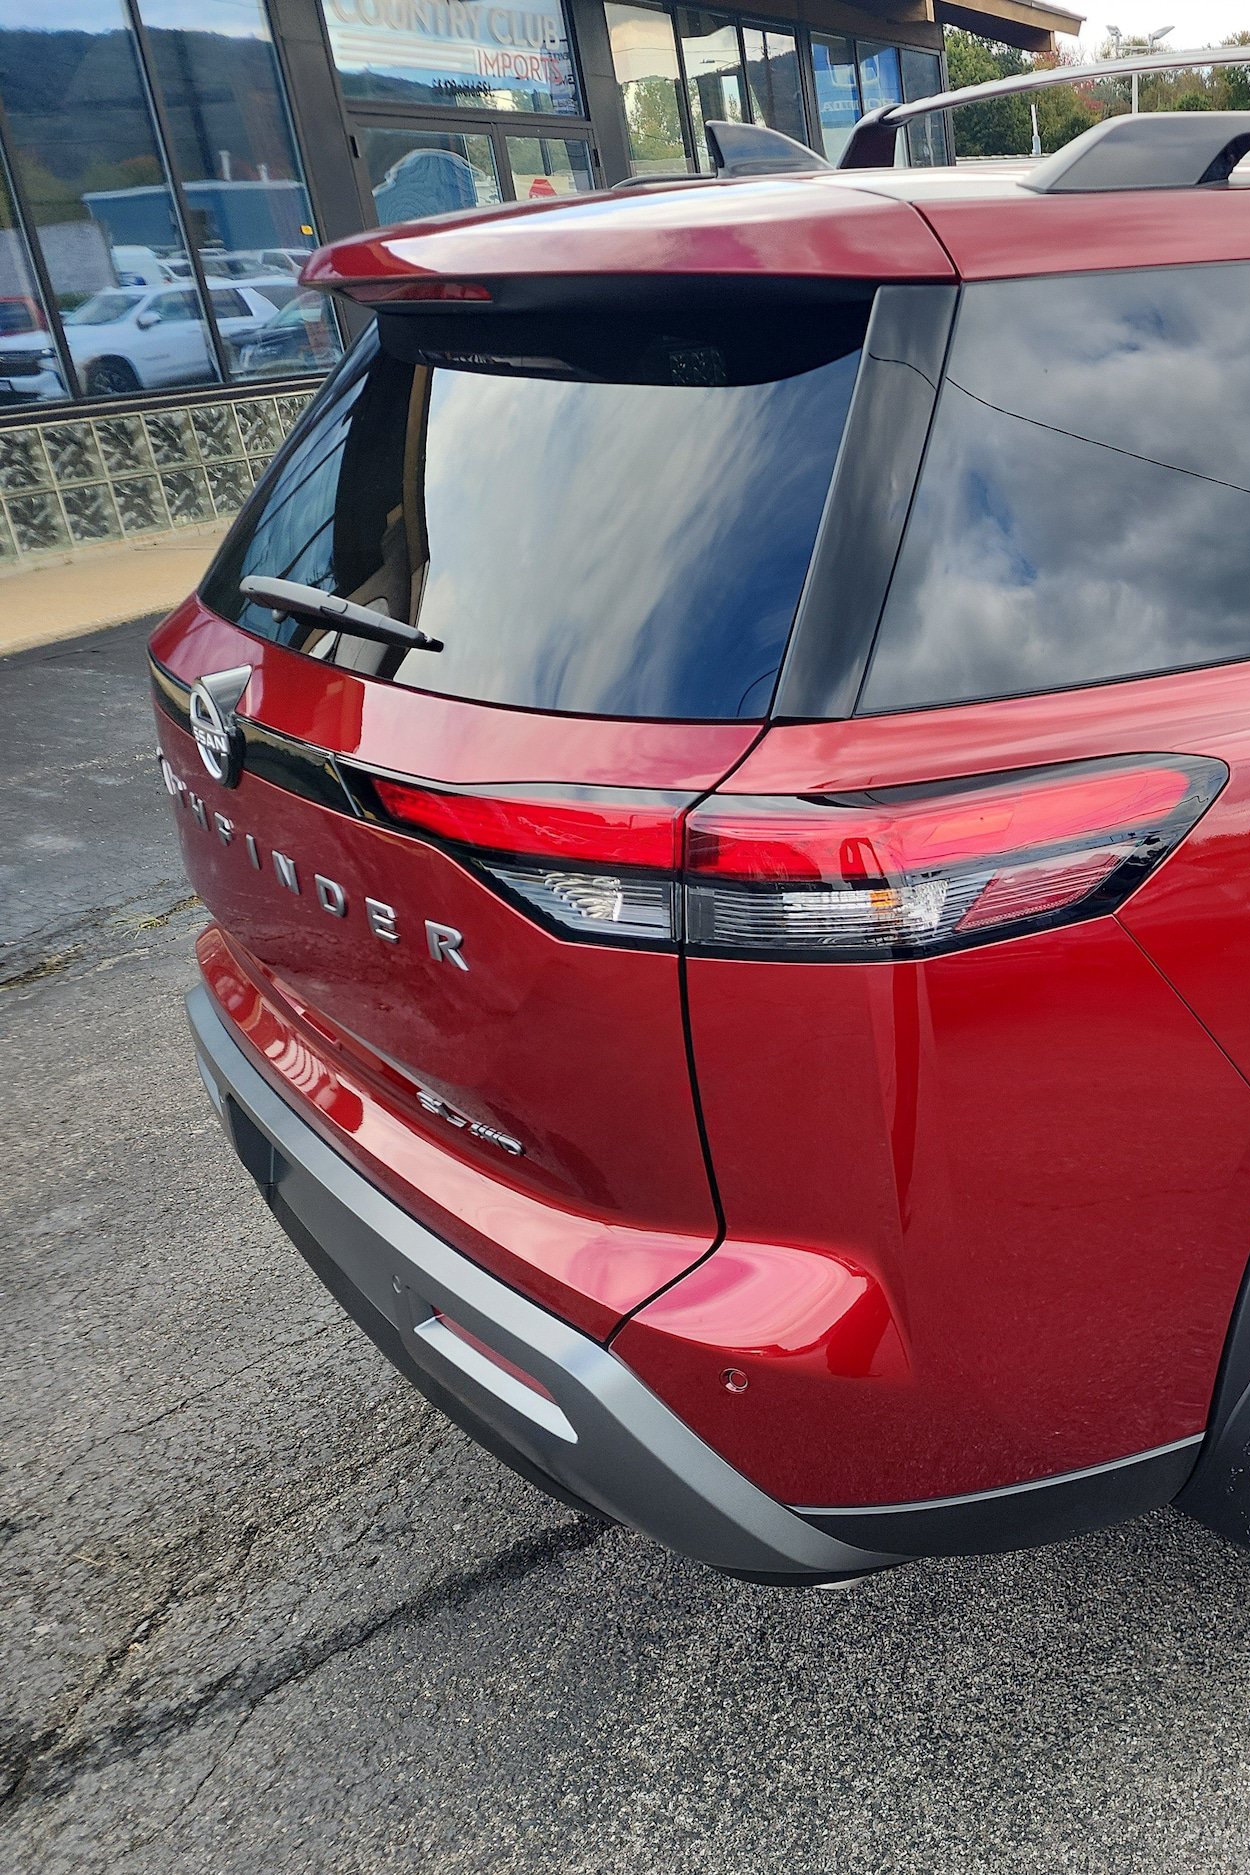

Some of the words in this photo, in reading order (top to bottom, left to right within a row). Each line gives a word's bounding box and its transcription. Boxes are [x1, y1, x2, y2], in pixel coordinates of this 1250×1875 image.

[329, 0, 482, 42] COUNTRY
[487, 7, 561, 50] CLUB
[477, 50, 563, 85] IMPORTS
